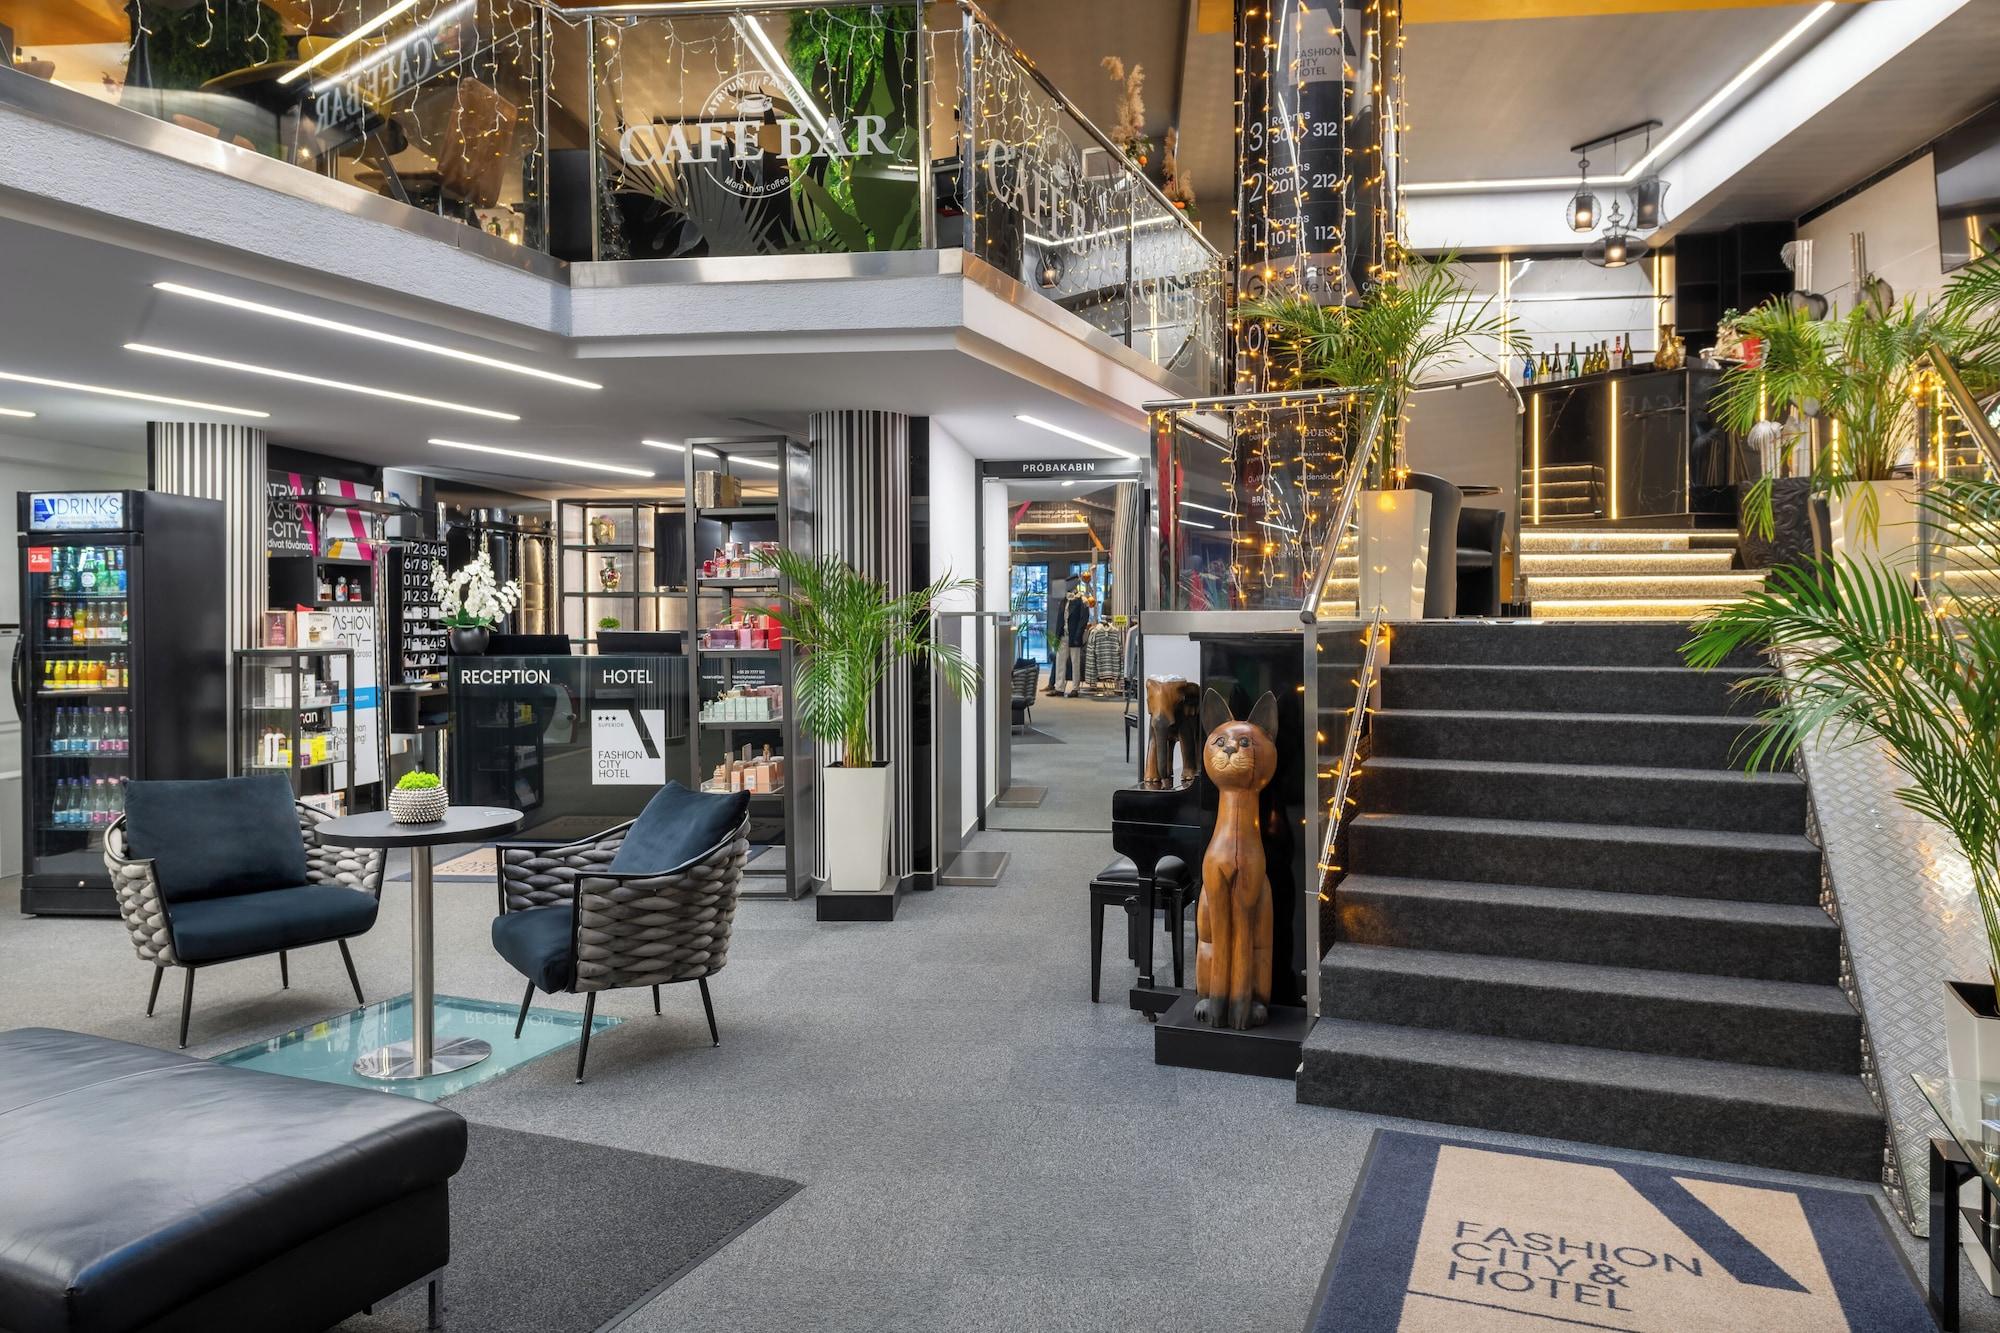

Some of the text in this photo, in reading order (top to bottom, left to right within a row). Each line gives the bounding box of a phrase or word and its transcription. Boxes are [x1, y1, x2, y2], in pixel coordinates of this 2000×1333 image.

[763, 76, 806, 109] FAHION
[620, 114, 894, 166] CAFE BAR
[1249, 122, 1263, 151] 3
[1312, 122, 1338, 137] 312
[725, 175, 744, 191] More
[766, 175, 789, 191] coffee
[1248, 172, 1338, 203] 2 201 212
[1271, 230, 1292, 246] 101
[1314, 225, 1337, 240] 112
[1022, 462, 1095, 473] PRÓBAKABIN
[1297, 472, 1341, 480] sedenstick
[57, 495, 119, 515] DRINKS
[267, 501, 313, 521] ASHION
[273, 521, 301, 538] CITY
[333, 615, 371, 630] ASHION
[461, 669, 550, 685] RECEPTION
[603, 669, 653, 684] HOTEL
[598, 750, 643, 760] FASHION
[598, 760, 621, 769] CITY
[598, 769, 630, 778] HOTEL
[1456, 1221, 1703, 1277] FASHION
[1452, 1242, 1630, 1288] CITY &
[1448, 1261, 1632, 1312] HOTEL
